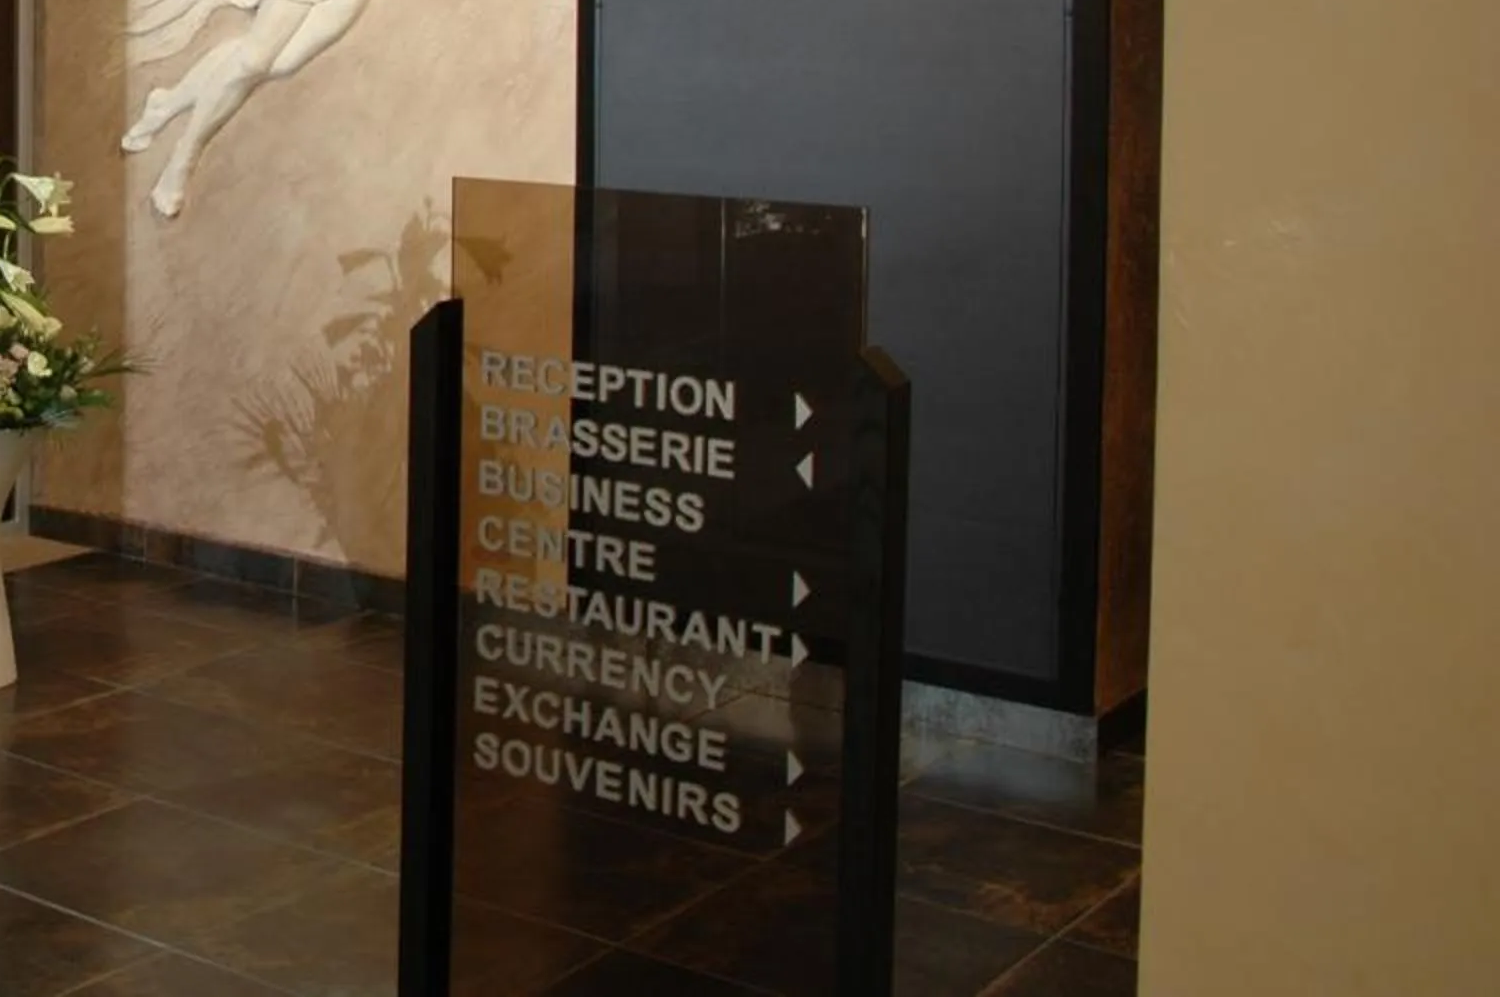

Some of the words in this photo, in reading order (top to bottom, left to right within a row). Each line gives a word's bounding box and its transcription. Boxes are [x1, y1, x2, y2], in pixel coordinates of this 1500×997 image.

[480, 349, 736, 421] RECEPTION
[479, 405, 736, 479] BRASSERIE
[478, 459, 705, 534] BUSINESS
[477, 514, 656, 582] CENTRE
[476, 566, 781, 664] RESTAURANT
[475, 623, 727, 711] CURRENCY
[474, 676, 726, 772] EXCHANGE
[473, 733, 741, 834] SOUVENIRS
